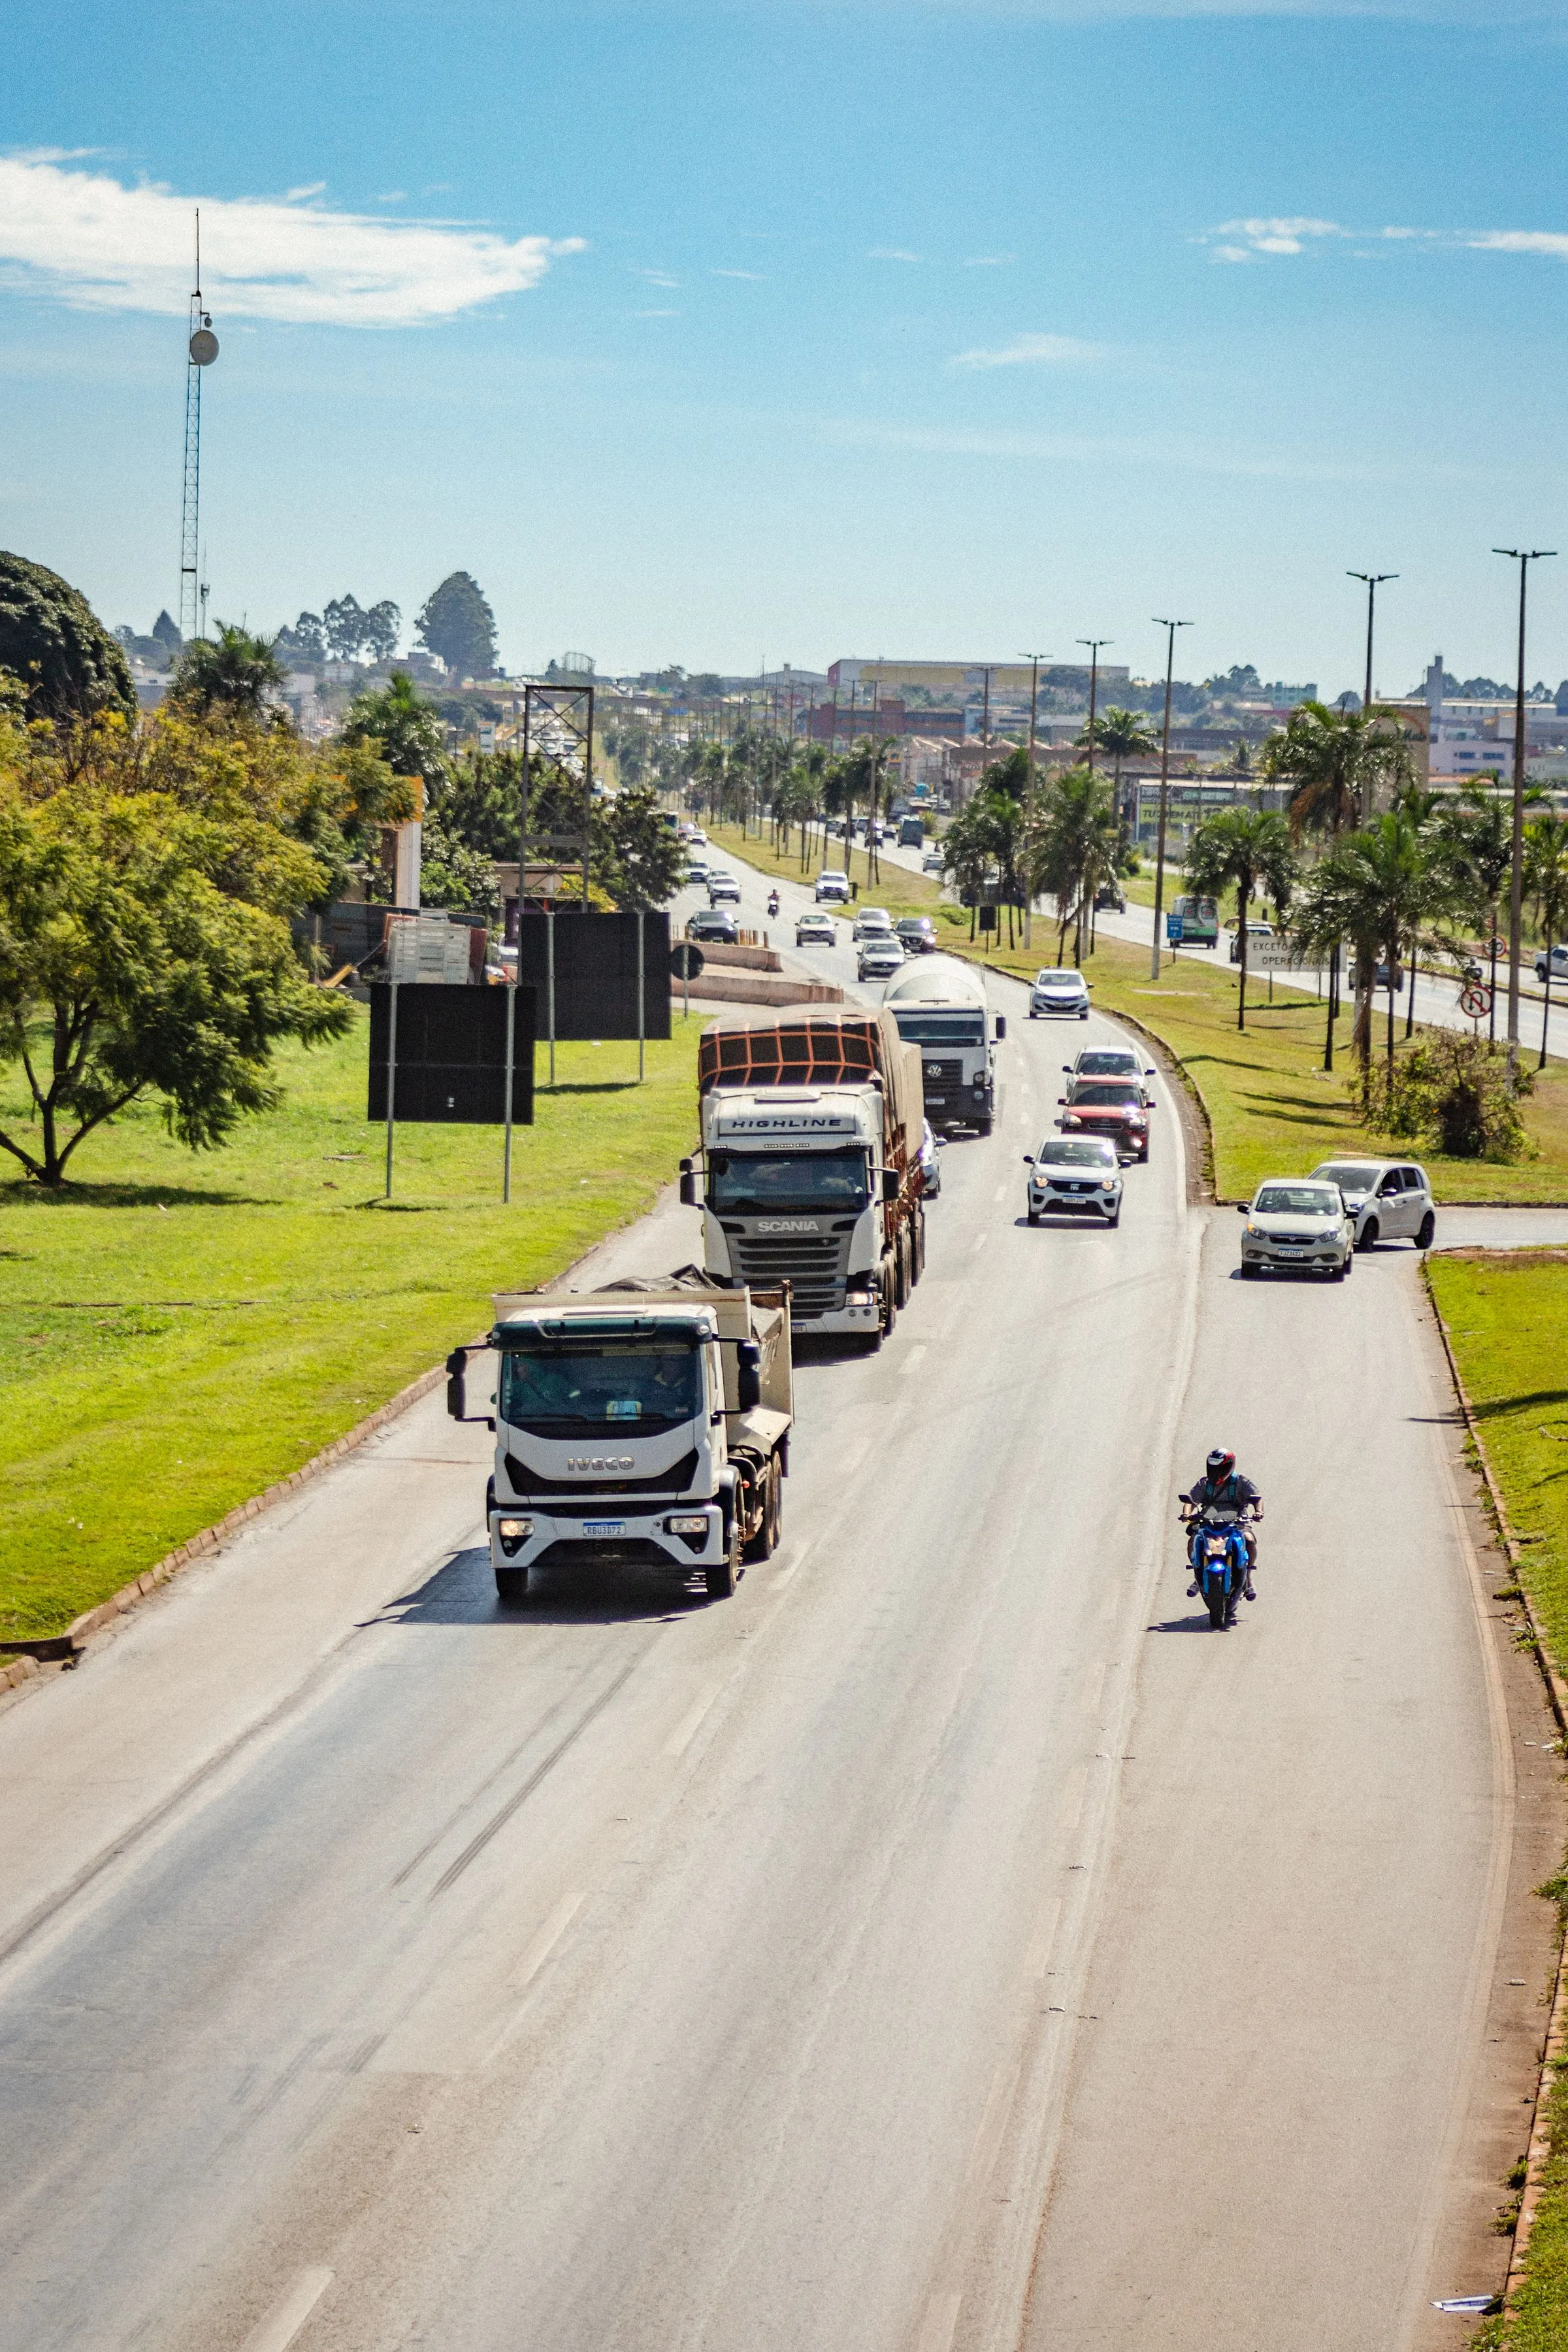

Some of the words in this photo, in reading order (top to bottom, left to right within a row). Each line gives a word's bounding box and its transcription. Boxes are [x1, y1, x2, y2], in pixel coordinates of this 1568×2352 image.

[1252, 942, 1288, 952] EXCETO
[732, 1119, 842, 1128] HIGHLINE
[758, 1221, 819, 1232] SCANIA
[568, 1456, 635, 1471] IVECO
